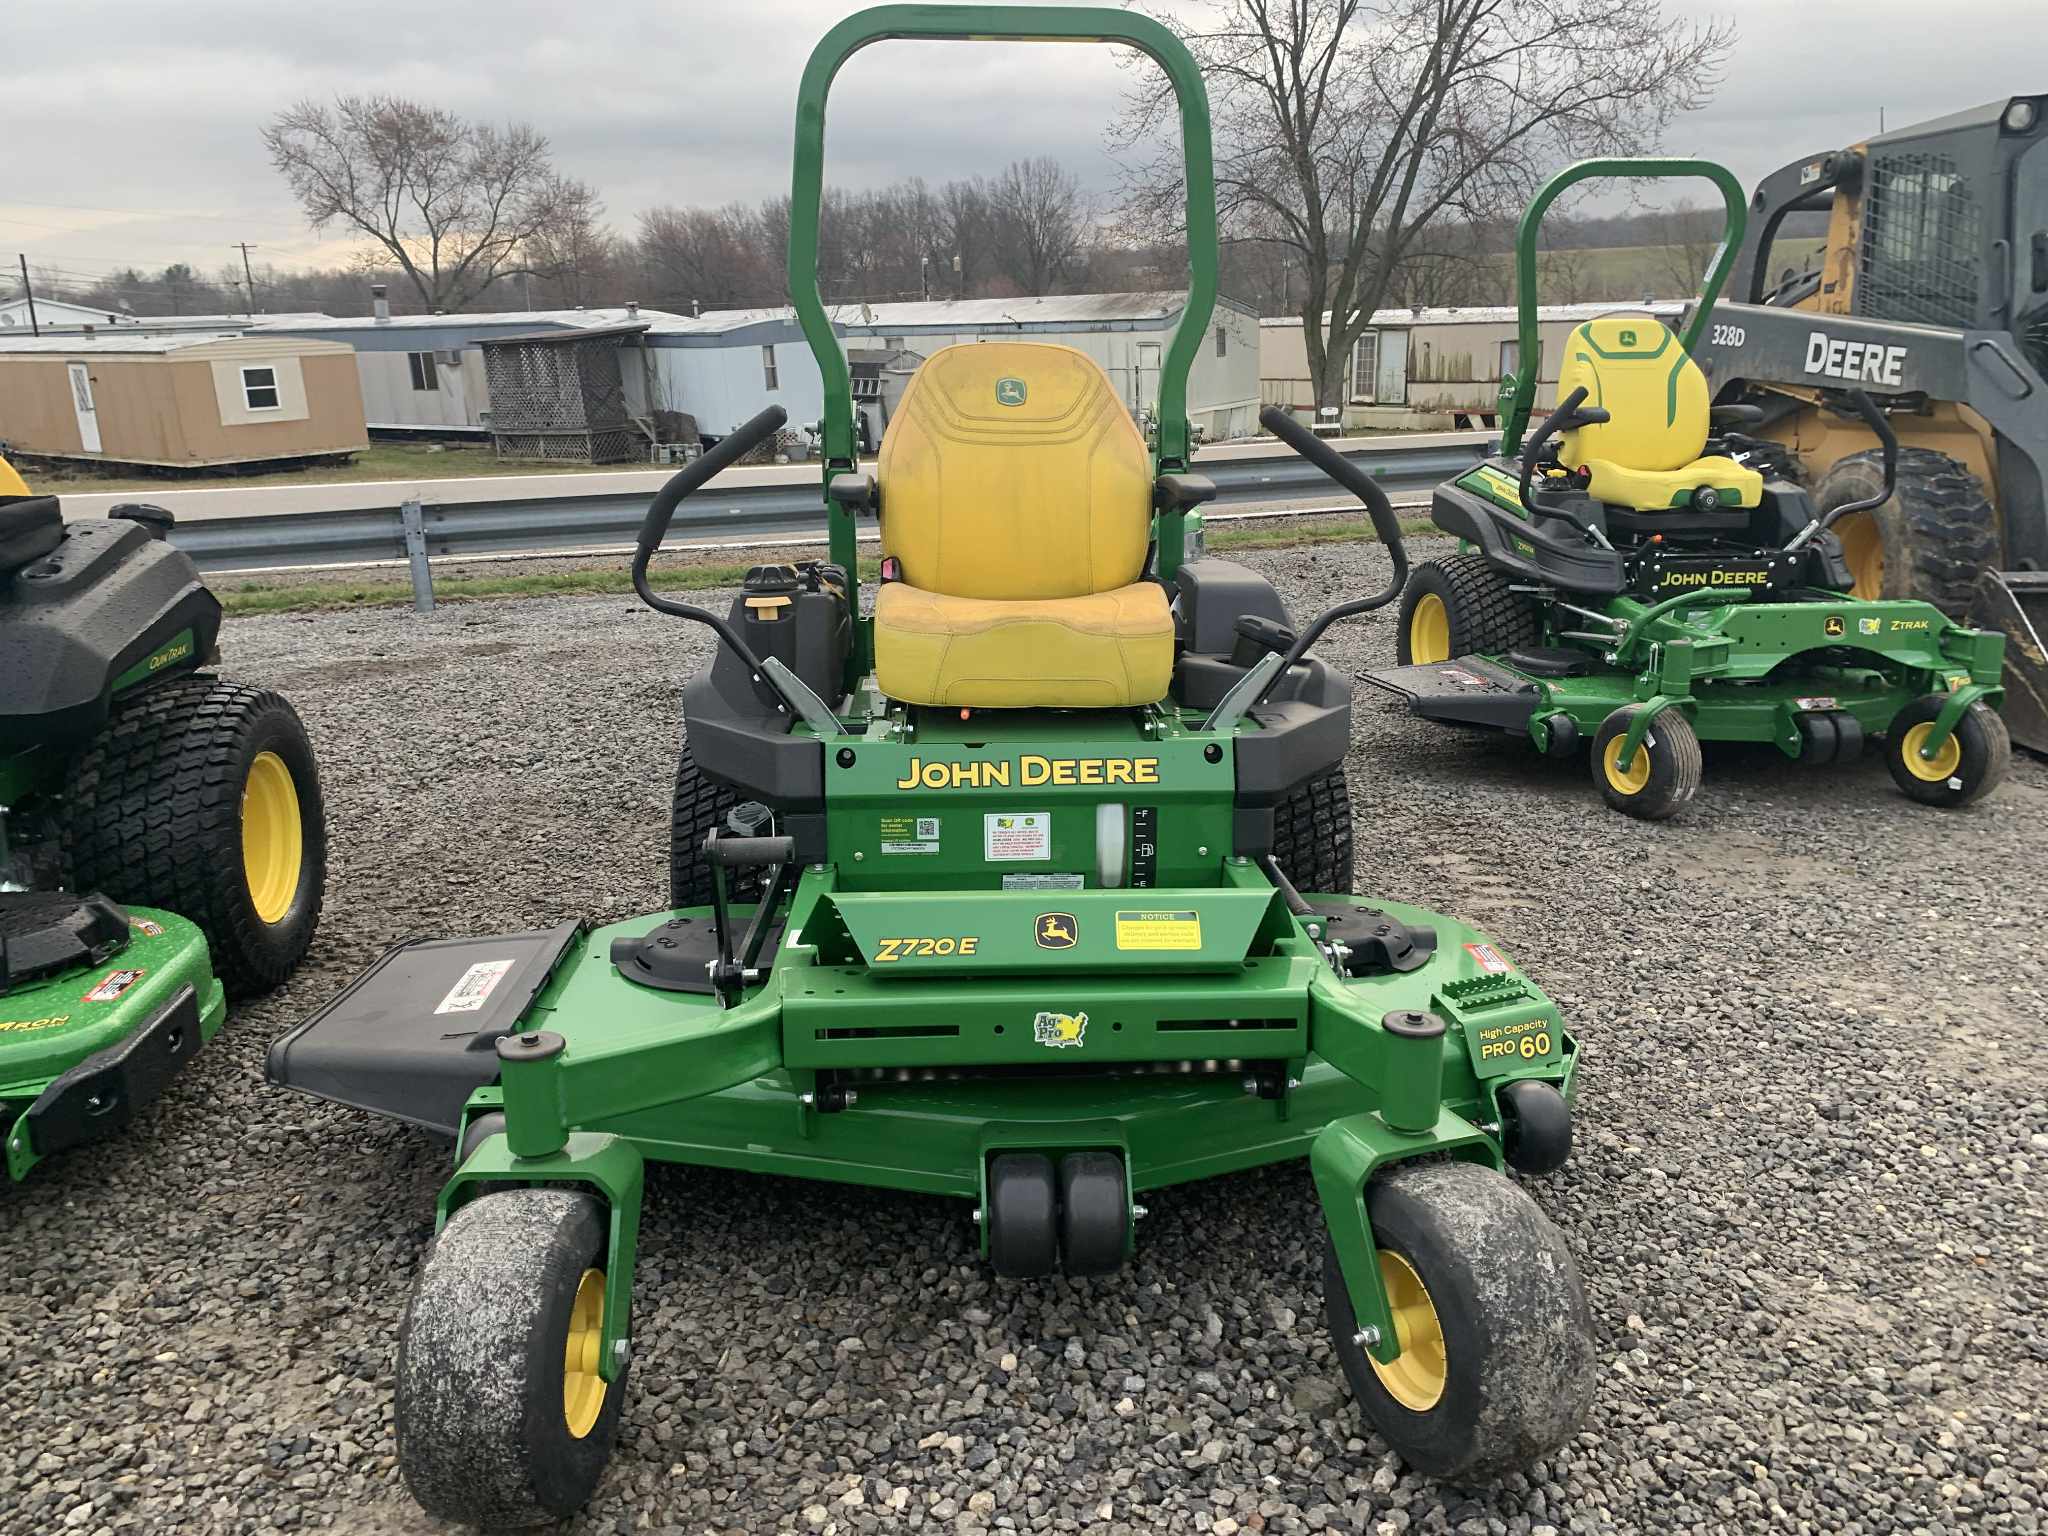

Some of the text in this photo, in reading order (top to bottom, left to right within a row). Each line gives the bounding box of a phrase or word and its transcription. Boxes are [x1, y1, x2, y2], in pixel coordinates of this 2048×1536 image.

[1711, 324, 1745, 347] 328D
[1804, 332, 1907, 386] DEERE
[1660, 570, 1768, 586] JOHN DEERE
[897, 754, 1160, 790] JOHN DEERE
[1142, 809, 1149, 818] F
[1140, 913, 1175, 921] NOTICE
[874, 936, 980, 962] Z720 E
[1038, 1028, 1062, 1039] Pro
[1479, 1019, 1548, 1041] High Capacity
[1481, 1032, 1551, 1060] PRO 60
